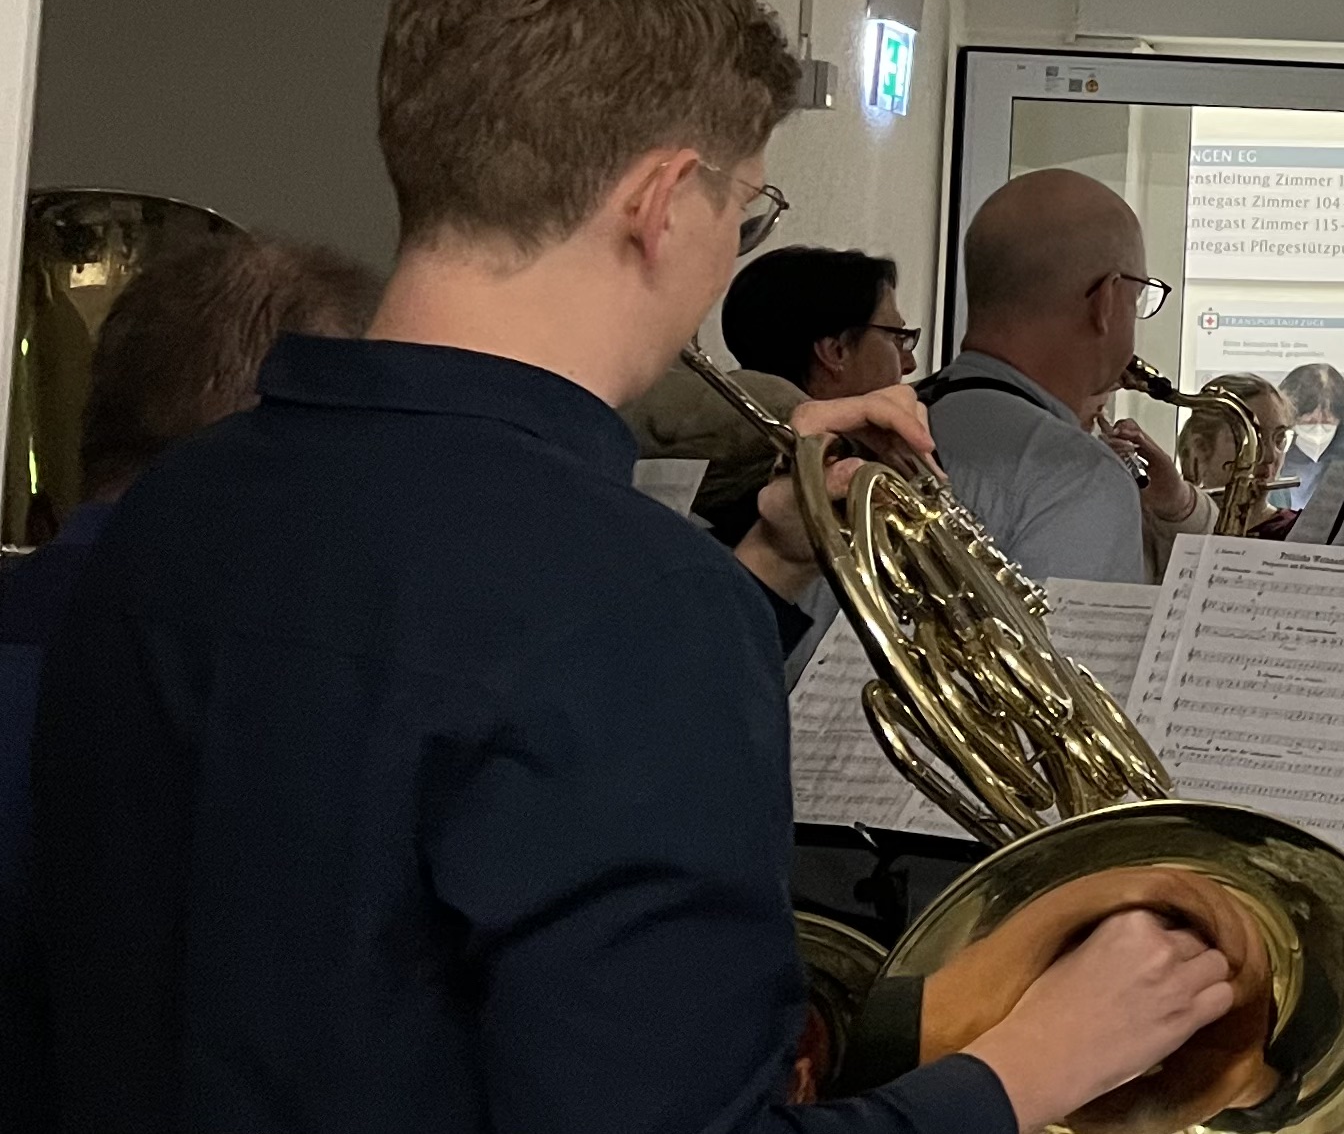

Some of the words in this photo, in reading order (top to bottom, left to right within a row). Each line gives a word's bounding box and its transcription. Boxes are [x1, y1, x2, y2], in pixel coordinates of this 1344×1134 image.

[1238, 150, 1257, 163] EG
[1191, 172, 1270, 188] nstleitung
[1275, 173, 1333, 187] Zimmer
[1190, 195, 1247, 209] ntegast
[1251, 195, 1310, 209] Zimmer
[1190, 217, 1247, 232] ntegast
[1250, 217, 1309, 231] Zimmer
[1190, 240, 1246, 255] ntegast
